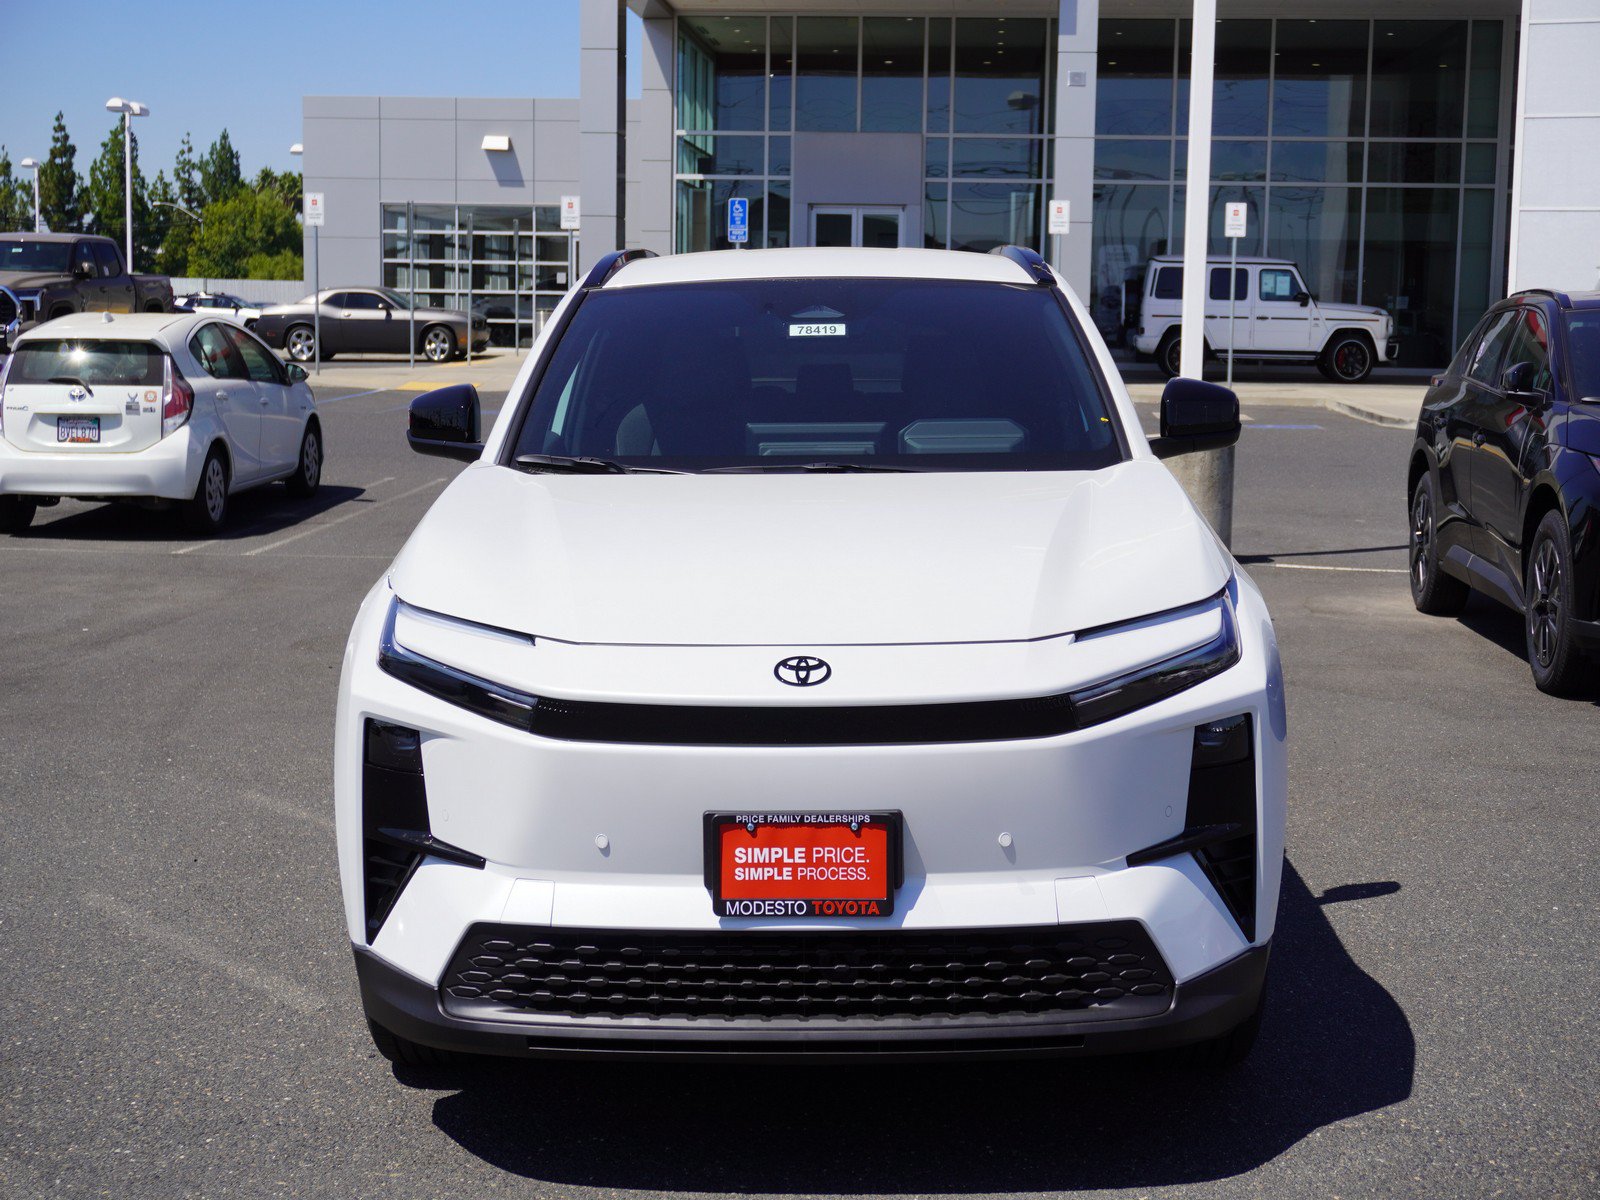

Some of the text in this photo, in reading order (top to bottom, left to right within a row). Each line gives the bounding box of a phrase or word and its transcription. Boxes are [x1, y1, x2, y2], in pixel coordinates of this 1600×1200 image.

[797, 325, 837, 335] 78419
[736, 815, 871, 823] PRICE FAMILY DEALERSHIPS
[734, 847, 871, 864] SIMPLE PRICE.
[734, 867, 871, 881] SIMPLE PROCESS.
[726, 901, 880, 915] MODESTO TOYOTA
